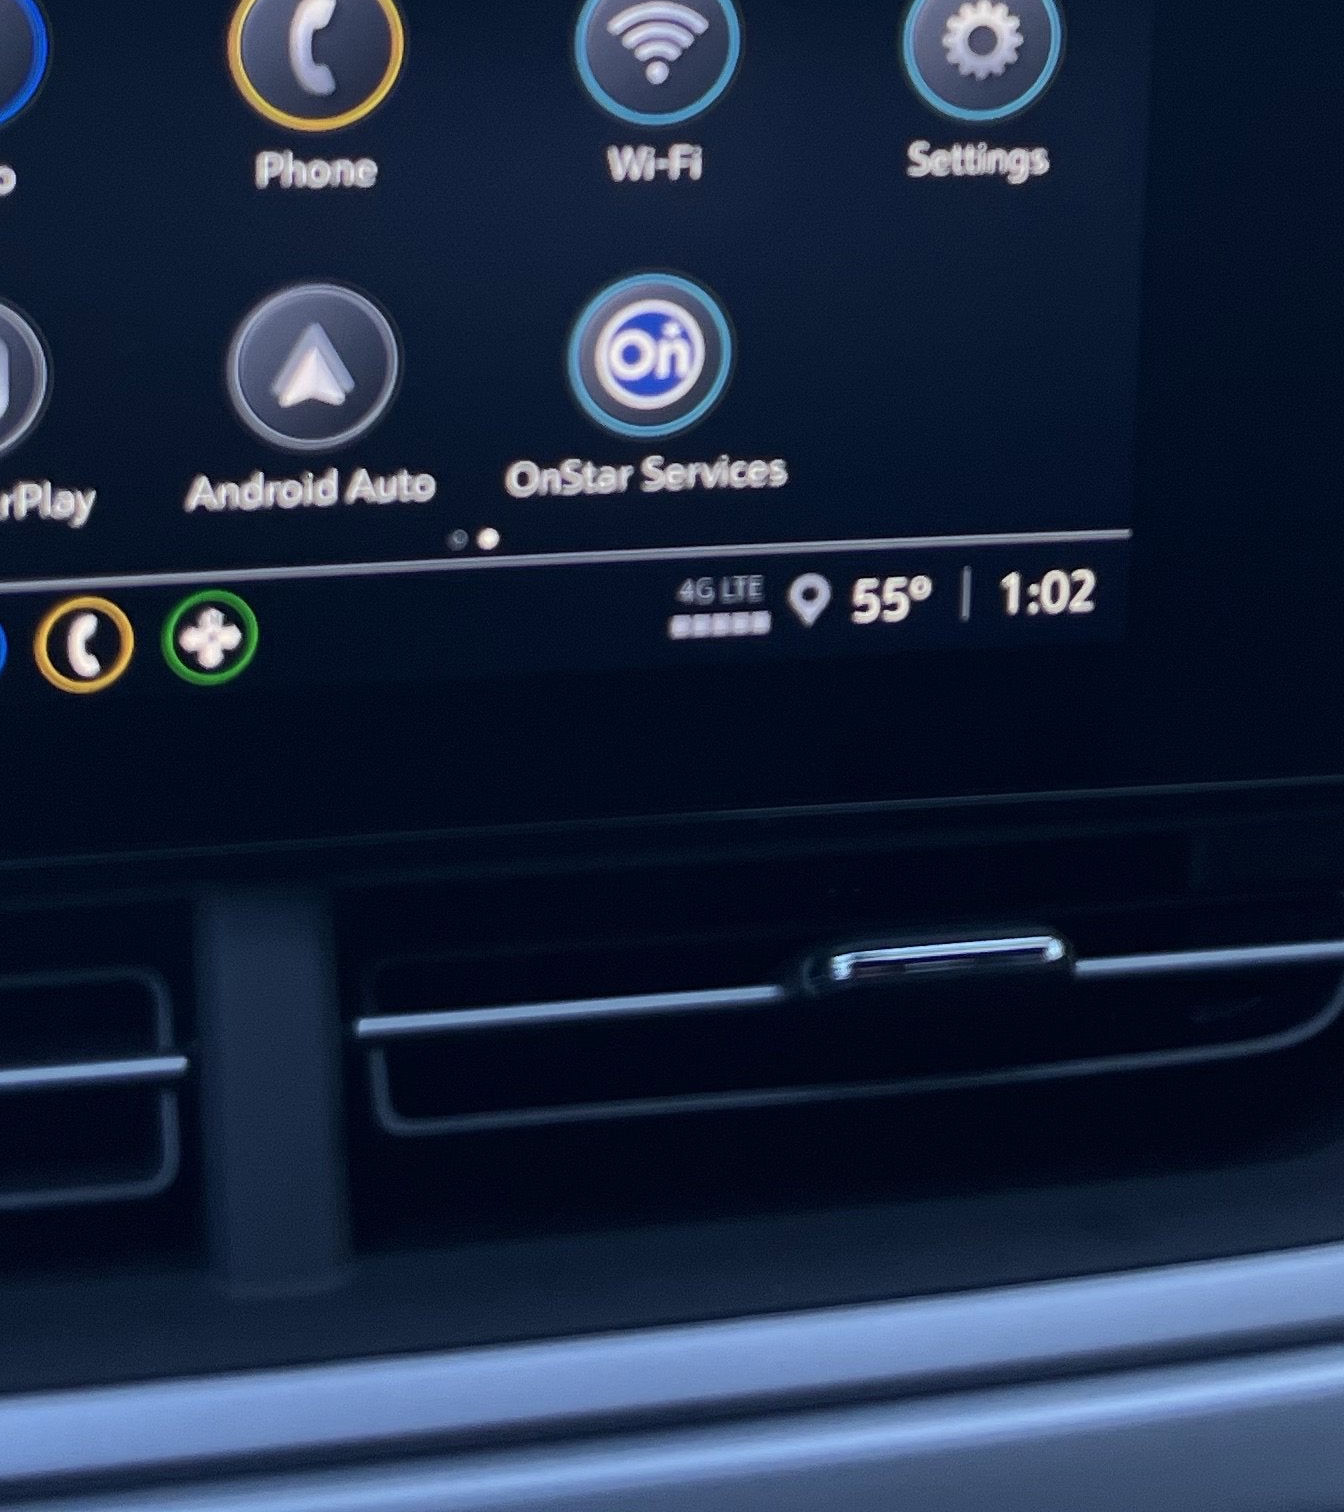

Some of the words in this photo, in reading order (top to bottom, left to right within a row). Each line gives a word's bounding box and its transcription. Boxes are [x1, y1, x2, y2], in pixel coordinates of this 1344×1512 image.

[254, 148, 380, 190] Phone
[605, 142, 703, 183] Wi-Fi
[906, 139, 1051, 185] Settings
[183, 466, 339, 513] Android
[343, 467, 437, 506] Auto
[504, 458, 635, 499] OnStar
[639, 453, 789, 493] Services
[678, 576, 716, 605] 4G
[720, 573, 765, 604] LTE
[999, 568, 1097, 616] 1:02
